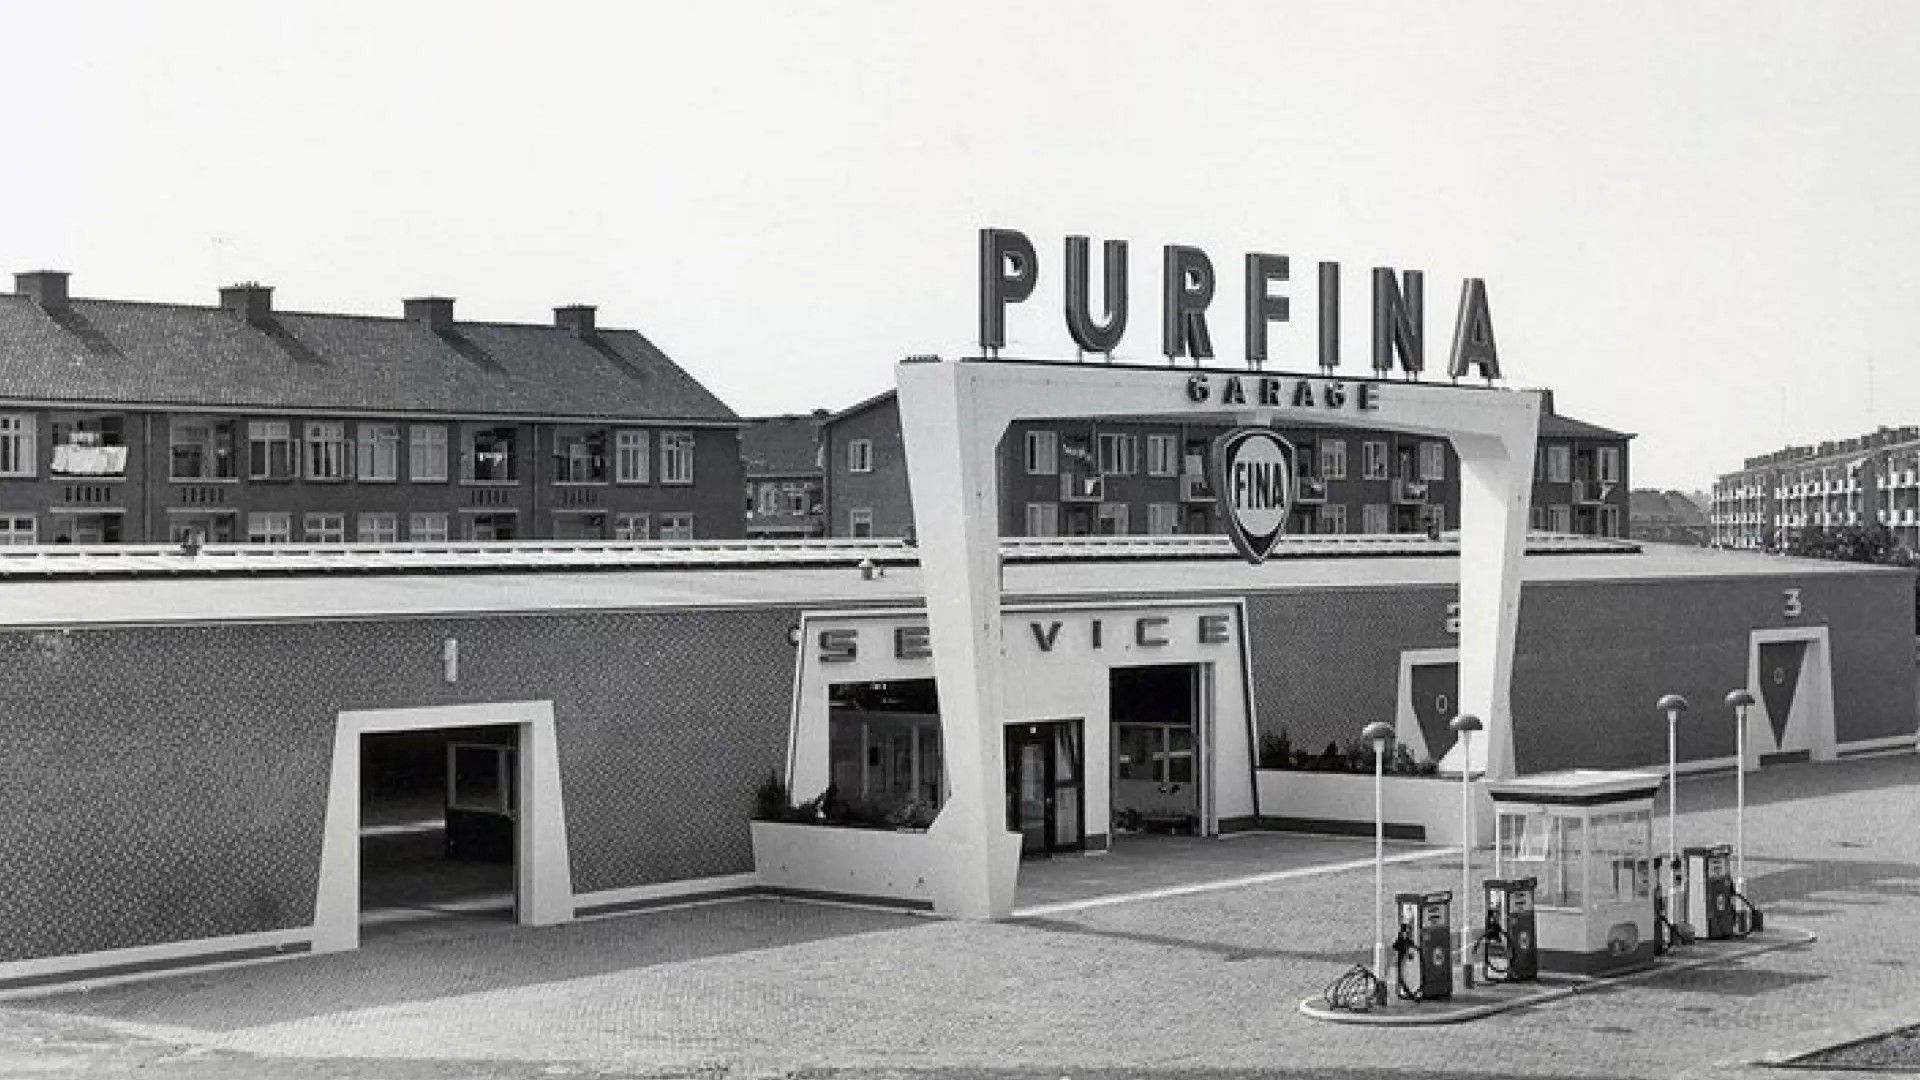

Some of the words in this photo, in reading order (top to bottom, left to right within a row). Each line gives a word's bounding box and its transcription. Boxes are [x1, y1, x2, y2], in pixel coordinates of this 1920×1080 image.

[979, 228, 1500, 379] PURFINA
[1187, 373, 1380, 410] GARAGE
[1235, 462, 1285, 508] FINA
[1783, 588, 1801, 617] 3
[819, 615, 1230, 662] SEVICE
